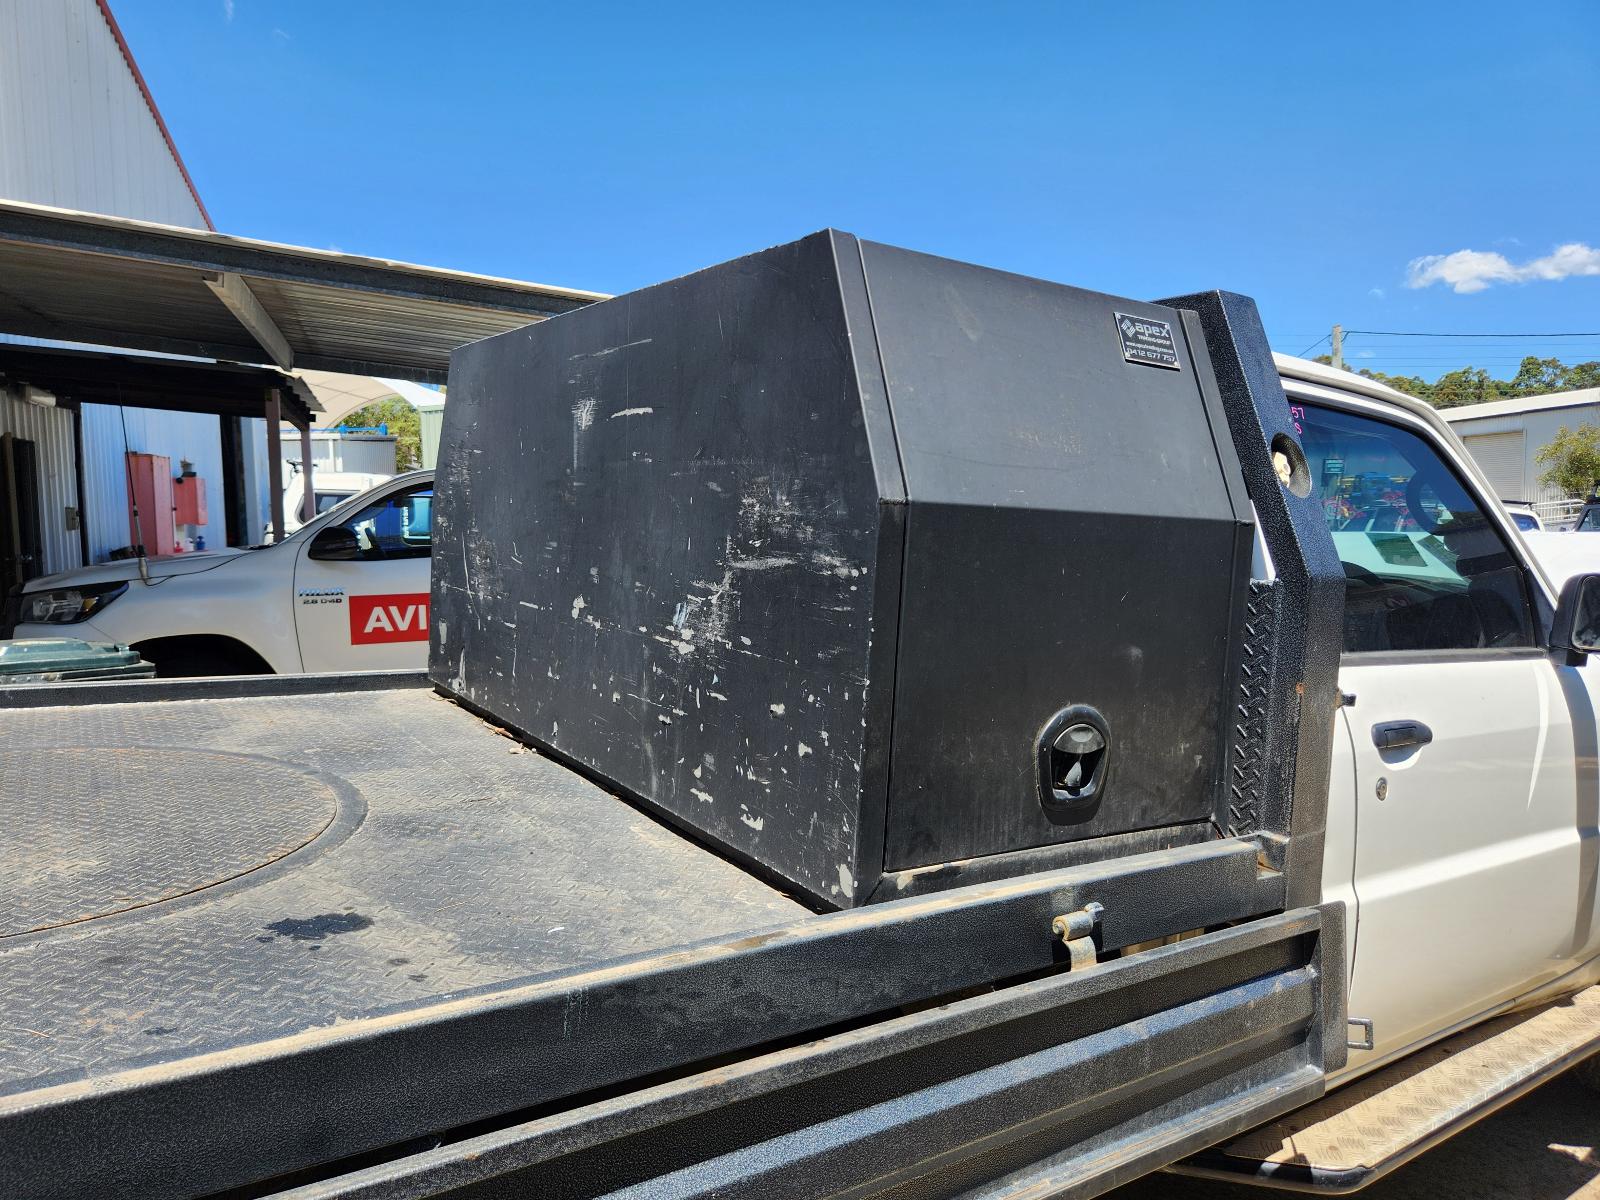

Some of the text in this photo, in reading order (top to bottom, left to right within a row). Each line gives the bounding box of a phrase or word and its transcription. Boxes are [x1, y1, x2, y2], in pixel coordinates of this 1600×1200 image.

[1135, 323, 1169, 337] apex
[1147, 351, 1160, 359] 677
[363, 604, 428, 633] AVI
